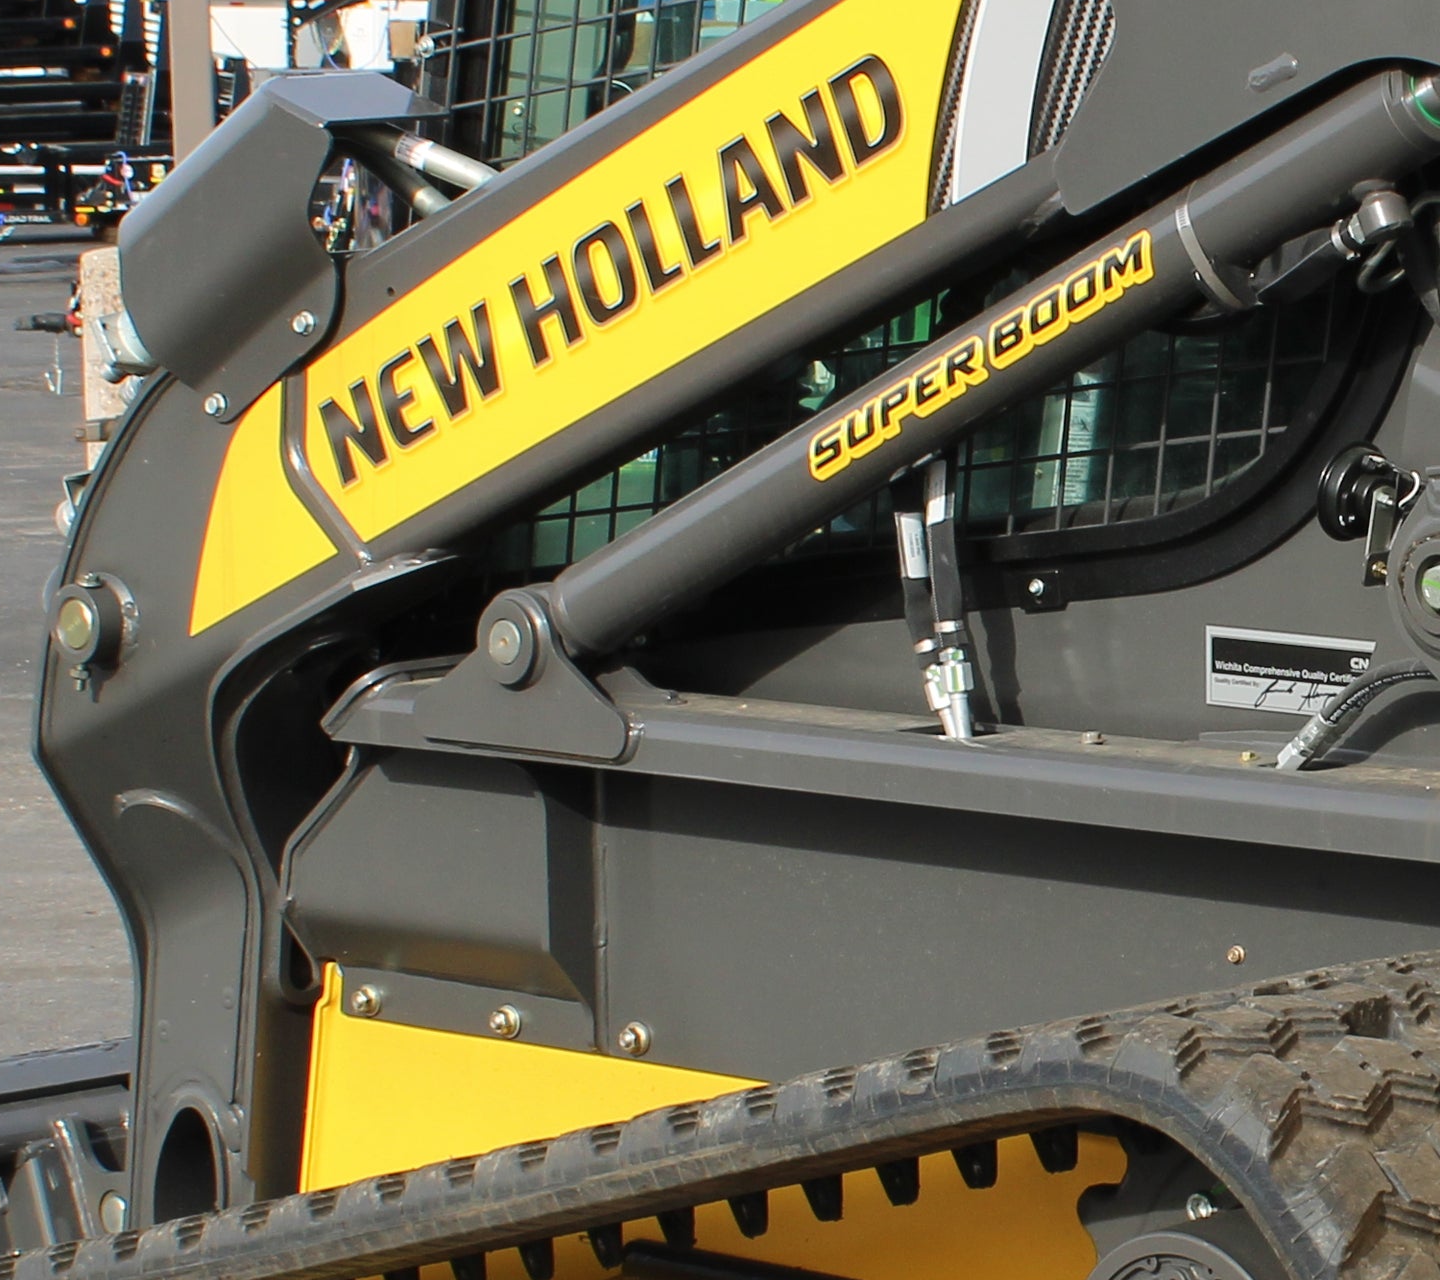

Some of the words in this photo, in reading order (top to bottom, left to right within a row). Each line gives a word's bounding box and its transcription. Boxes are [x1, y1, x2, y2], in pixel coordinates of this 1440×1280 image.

[318, 297, 503, 489] NEW
[508, 52, 905, 369] HOLLAND
[811, 337, 987, 478] SUPER
[990, 230, 1153, 367] BOOM
[1215, 660, 1242, 673] Wichita
[1243, 663, 1301, 679] Comprehensive
[1302, 669, 1329, 683] Quality
[1350, 656, 1370, 669] CN
